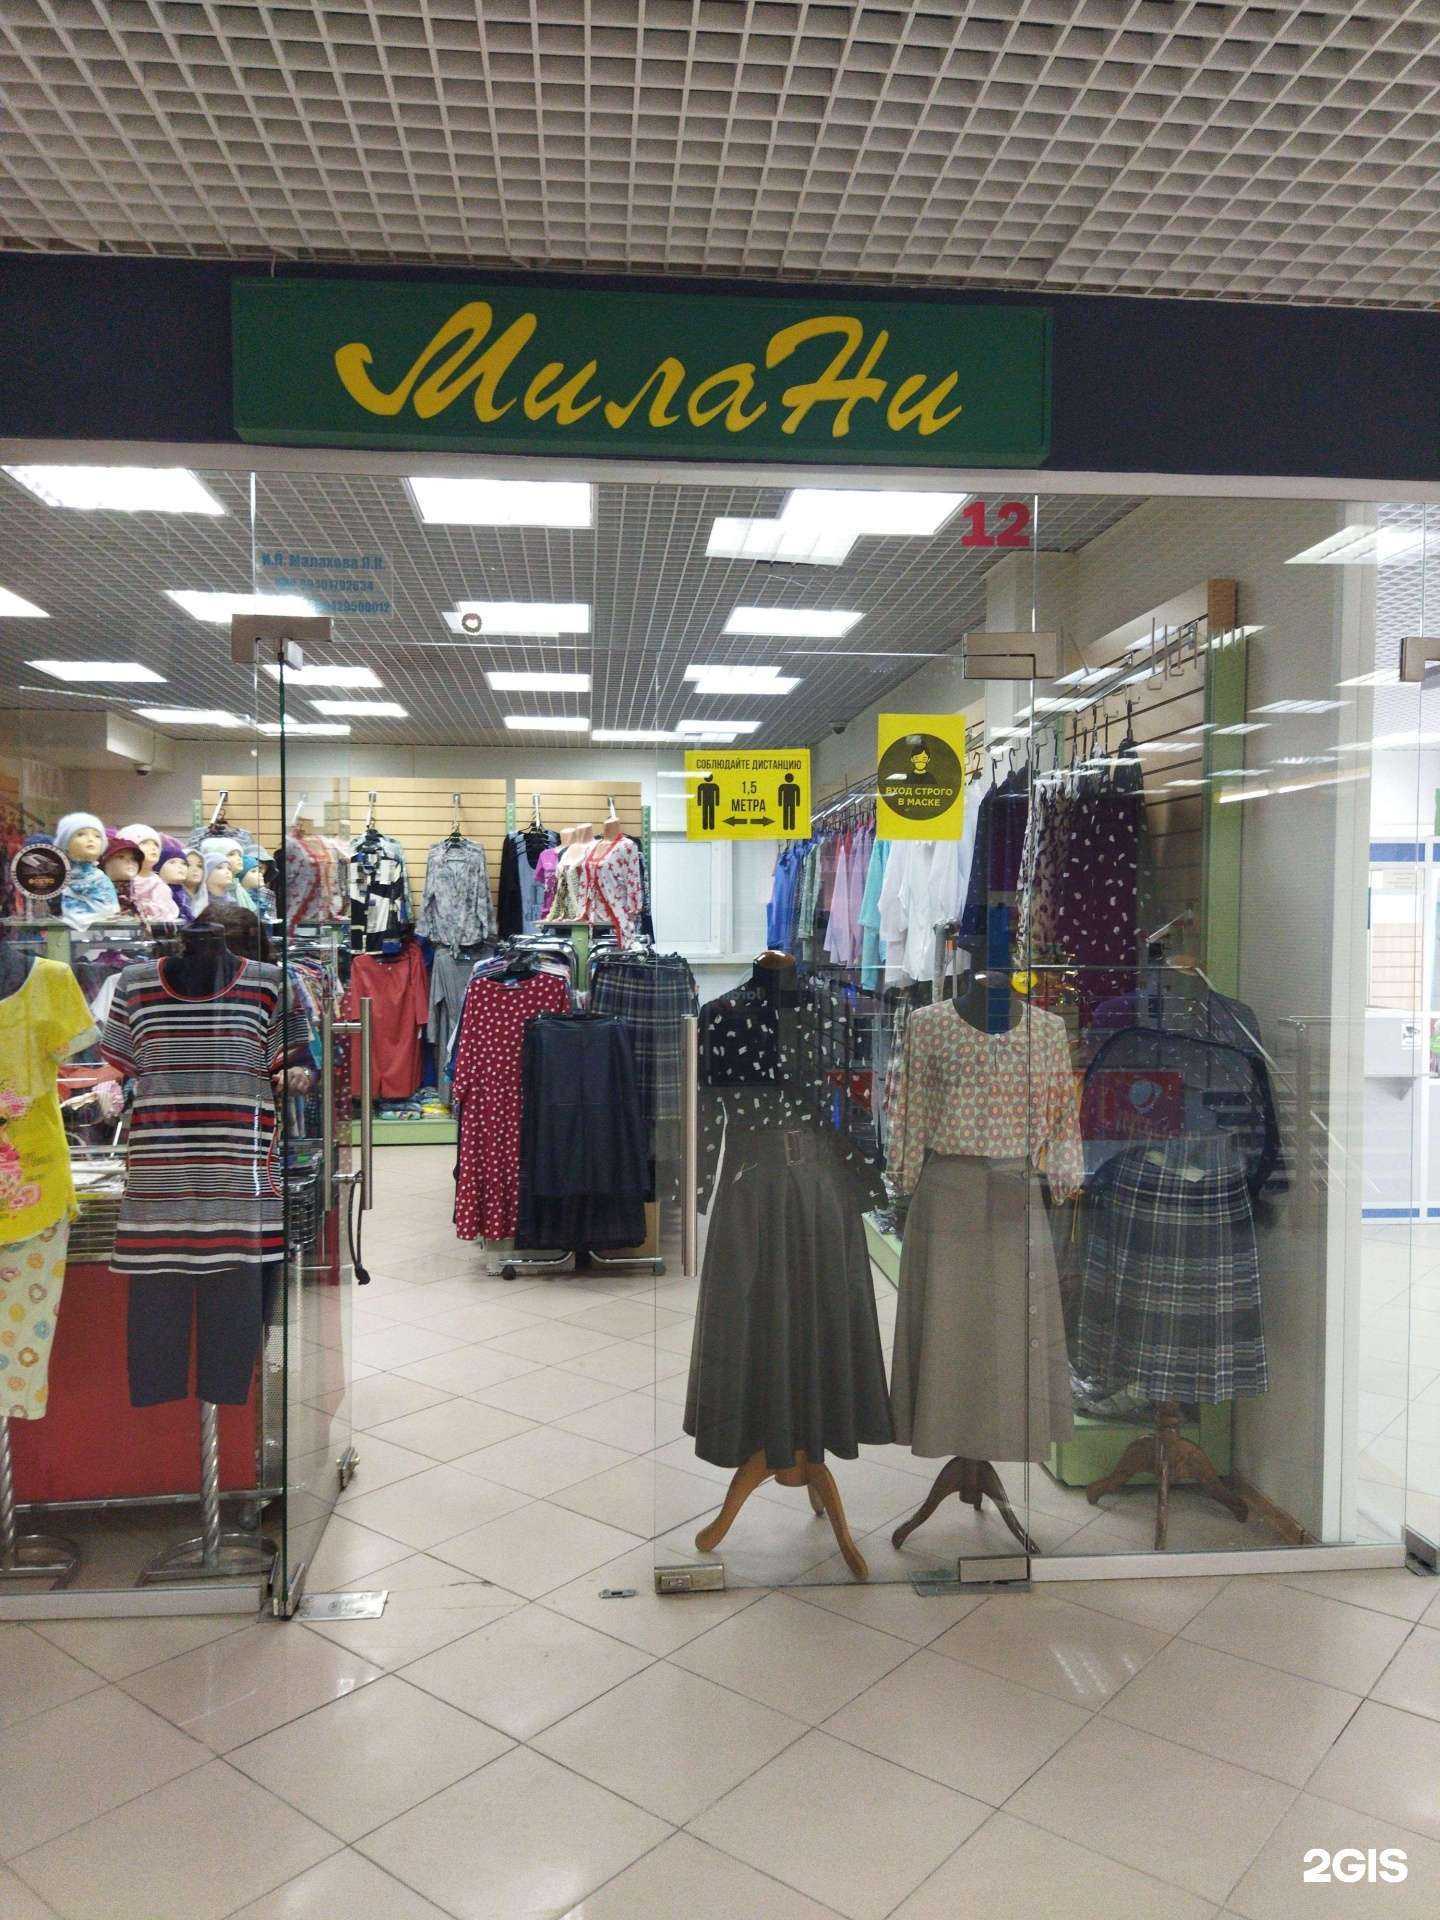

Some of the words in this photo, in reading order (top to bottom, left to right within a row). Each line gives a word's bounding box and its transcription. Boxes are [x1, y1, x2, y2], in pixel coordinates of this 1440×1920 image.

[334, 301, 964, 438] МилаНи
[961, 501, 1031, 548] 12
[696, 758, 751, 771] СОБЛЮДАЙТЕ
[752, 759, 802, 771] ДИСТАНЦИЮ
[741, 780, 757, 796] 1,5
[885, 786, 913, 797] ВХОД
[915, 787, 954, 797] СТРОГО
[731, 798, 767, 813] МЕТРА
[898, 797, 905, 807] В
[907, 797, 941, 808] МАСКЕ
